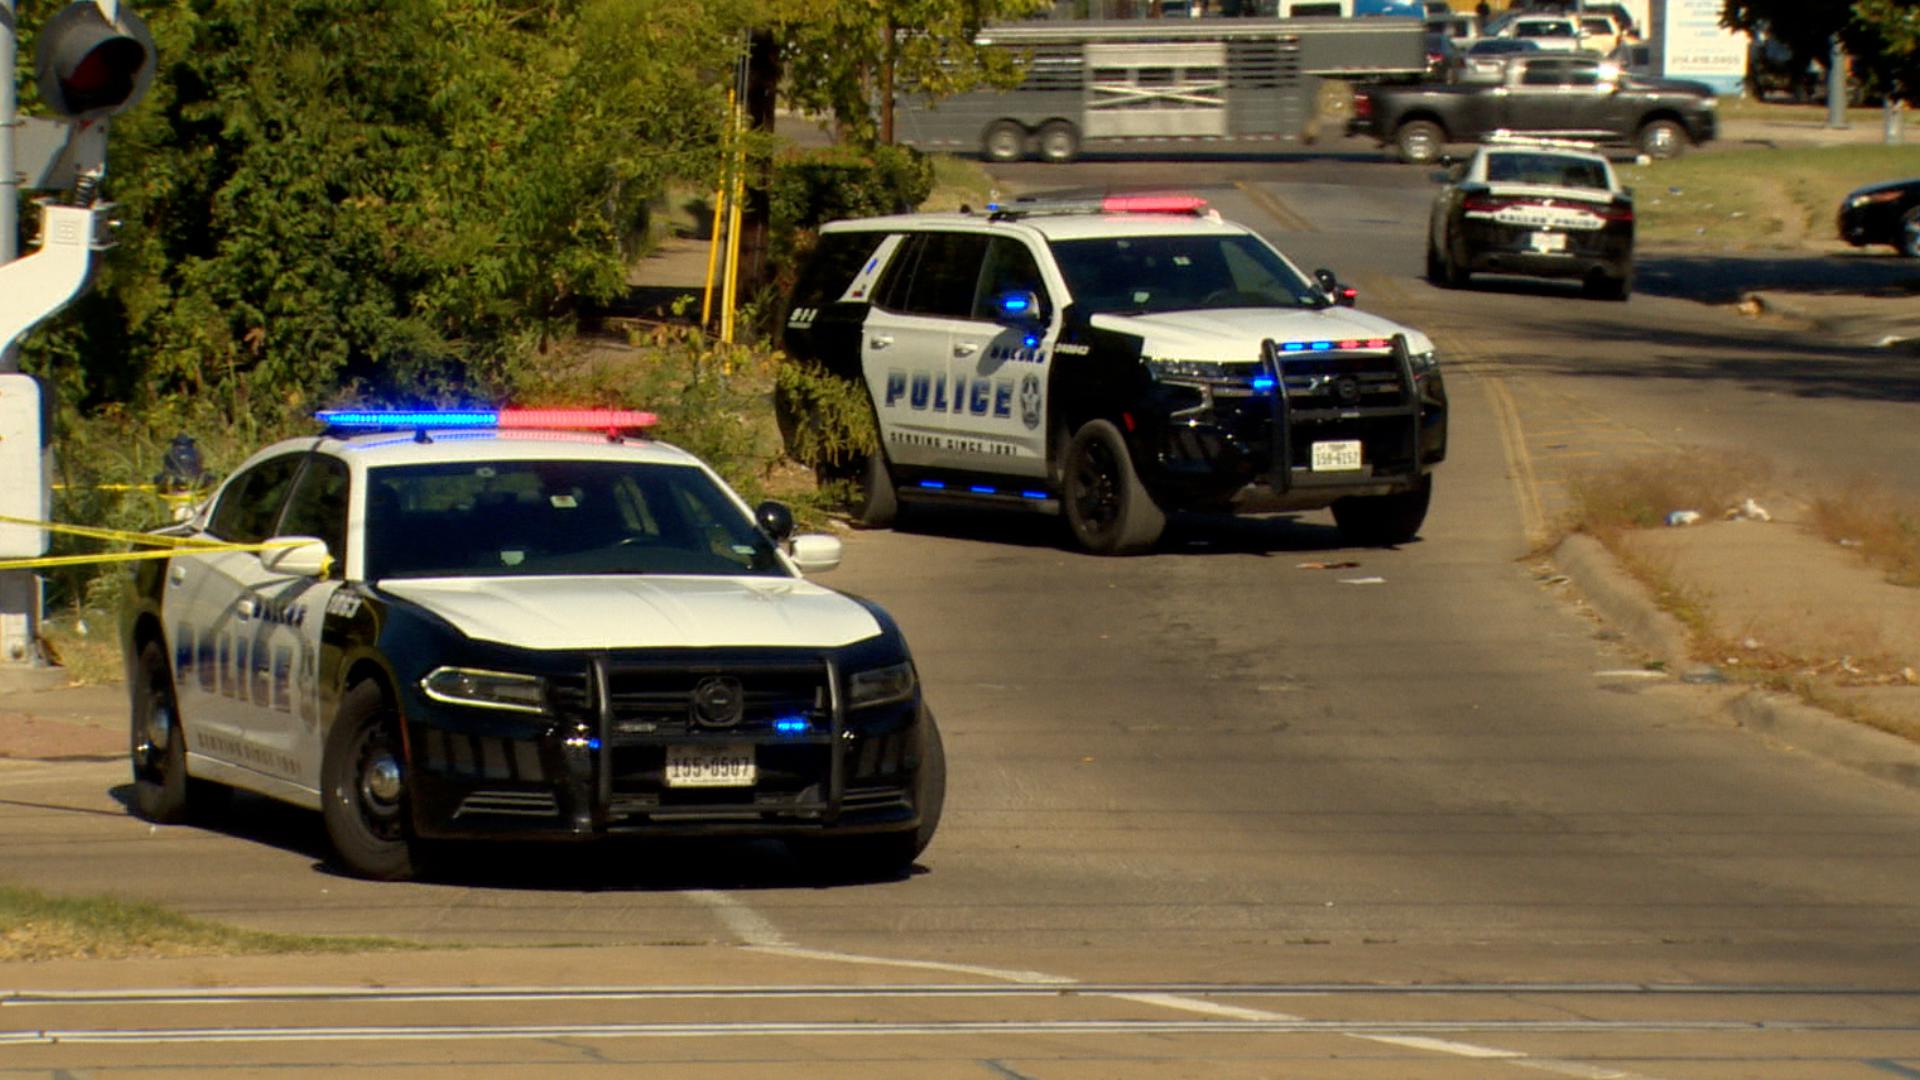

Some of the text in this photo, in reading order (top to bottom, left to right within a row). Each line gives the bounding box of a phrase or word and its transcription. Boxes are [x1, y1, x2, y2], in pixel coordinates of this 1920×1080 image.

[885, 368, 1014, 419] POLICE
[890, 432, 941, 448] SERVING
[947, 439, 983, 454] SINCE
[176, 623, 292, 713] POLICE
